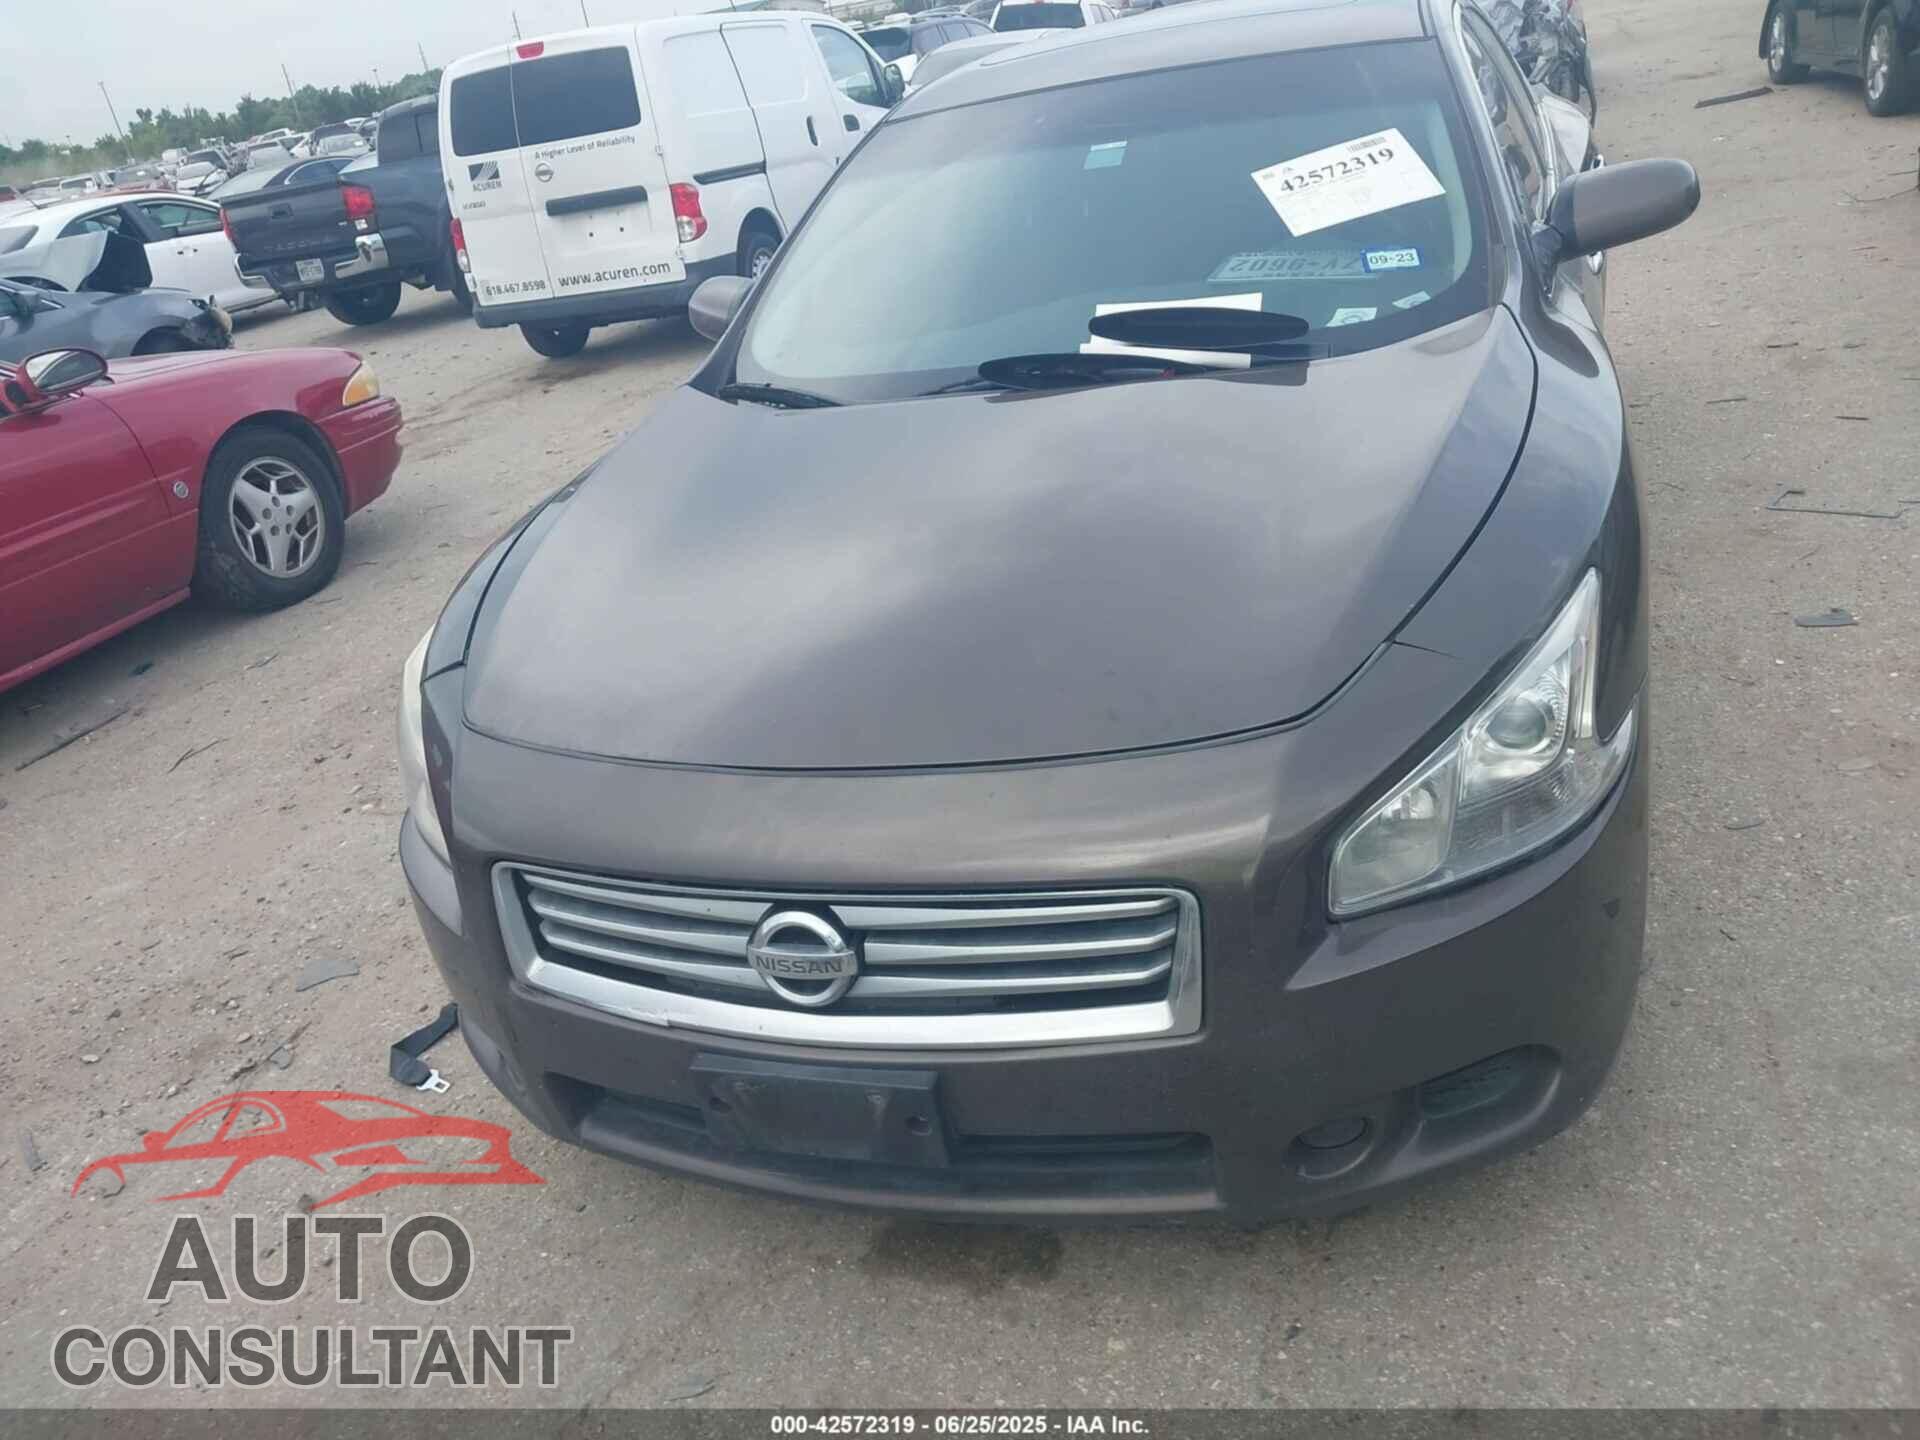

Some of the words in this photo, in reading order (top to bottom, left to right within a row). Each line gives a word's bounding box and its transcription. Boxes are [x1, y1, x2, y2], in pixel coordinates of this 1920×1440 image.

[541, 148, 565, 159] Higher
[566, 143, 586, 154] Level
[587, 140, 595, 150] of
[596, 135, 635, 148] Reliability
[1280, 147, 1394, 193] 42572319
[472, 180, 503, 192] ACUREN
[1369, 251, 1415, 266] 09-23
[557, 261, 672, 287] www.acuren.com
[485, 279, 546, 296] 618.467.8598
[755, 955, 843, 974] NISSAN
